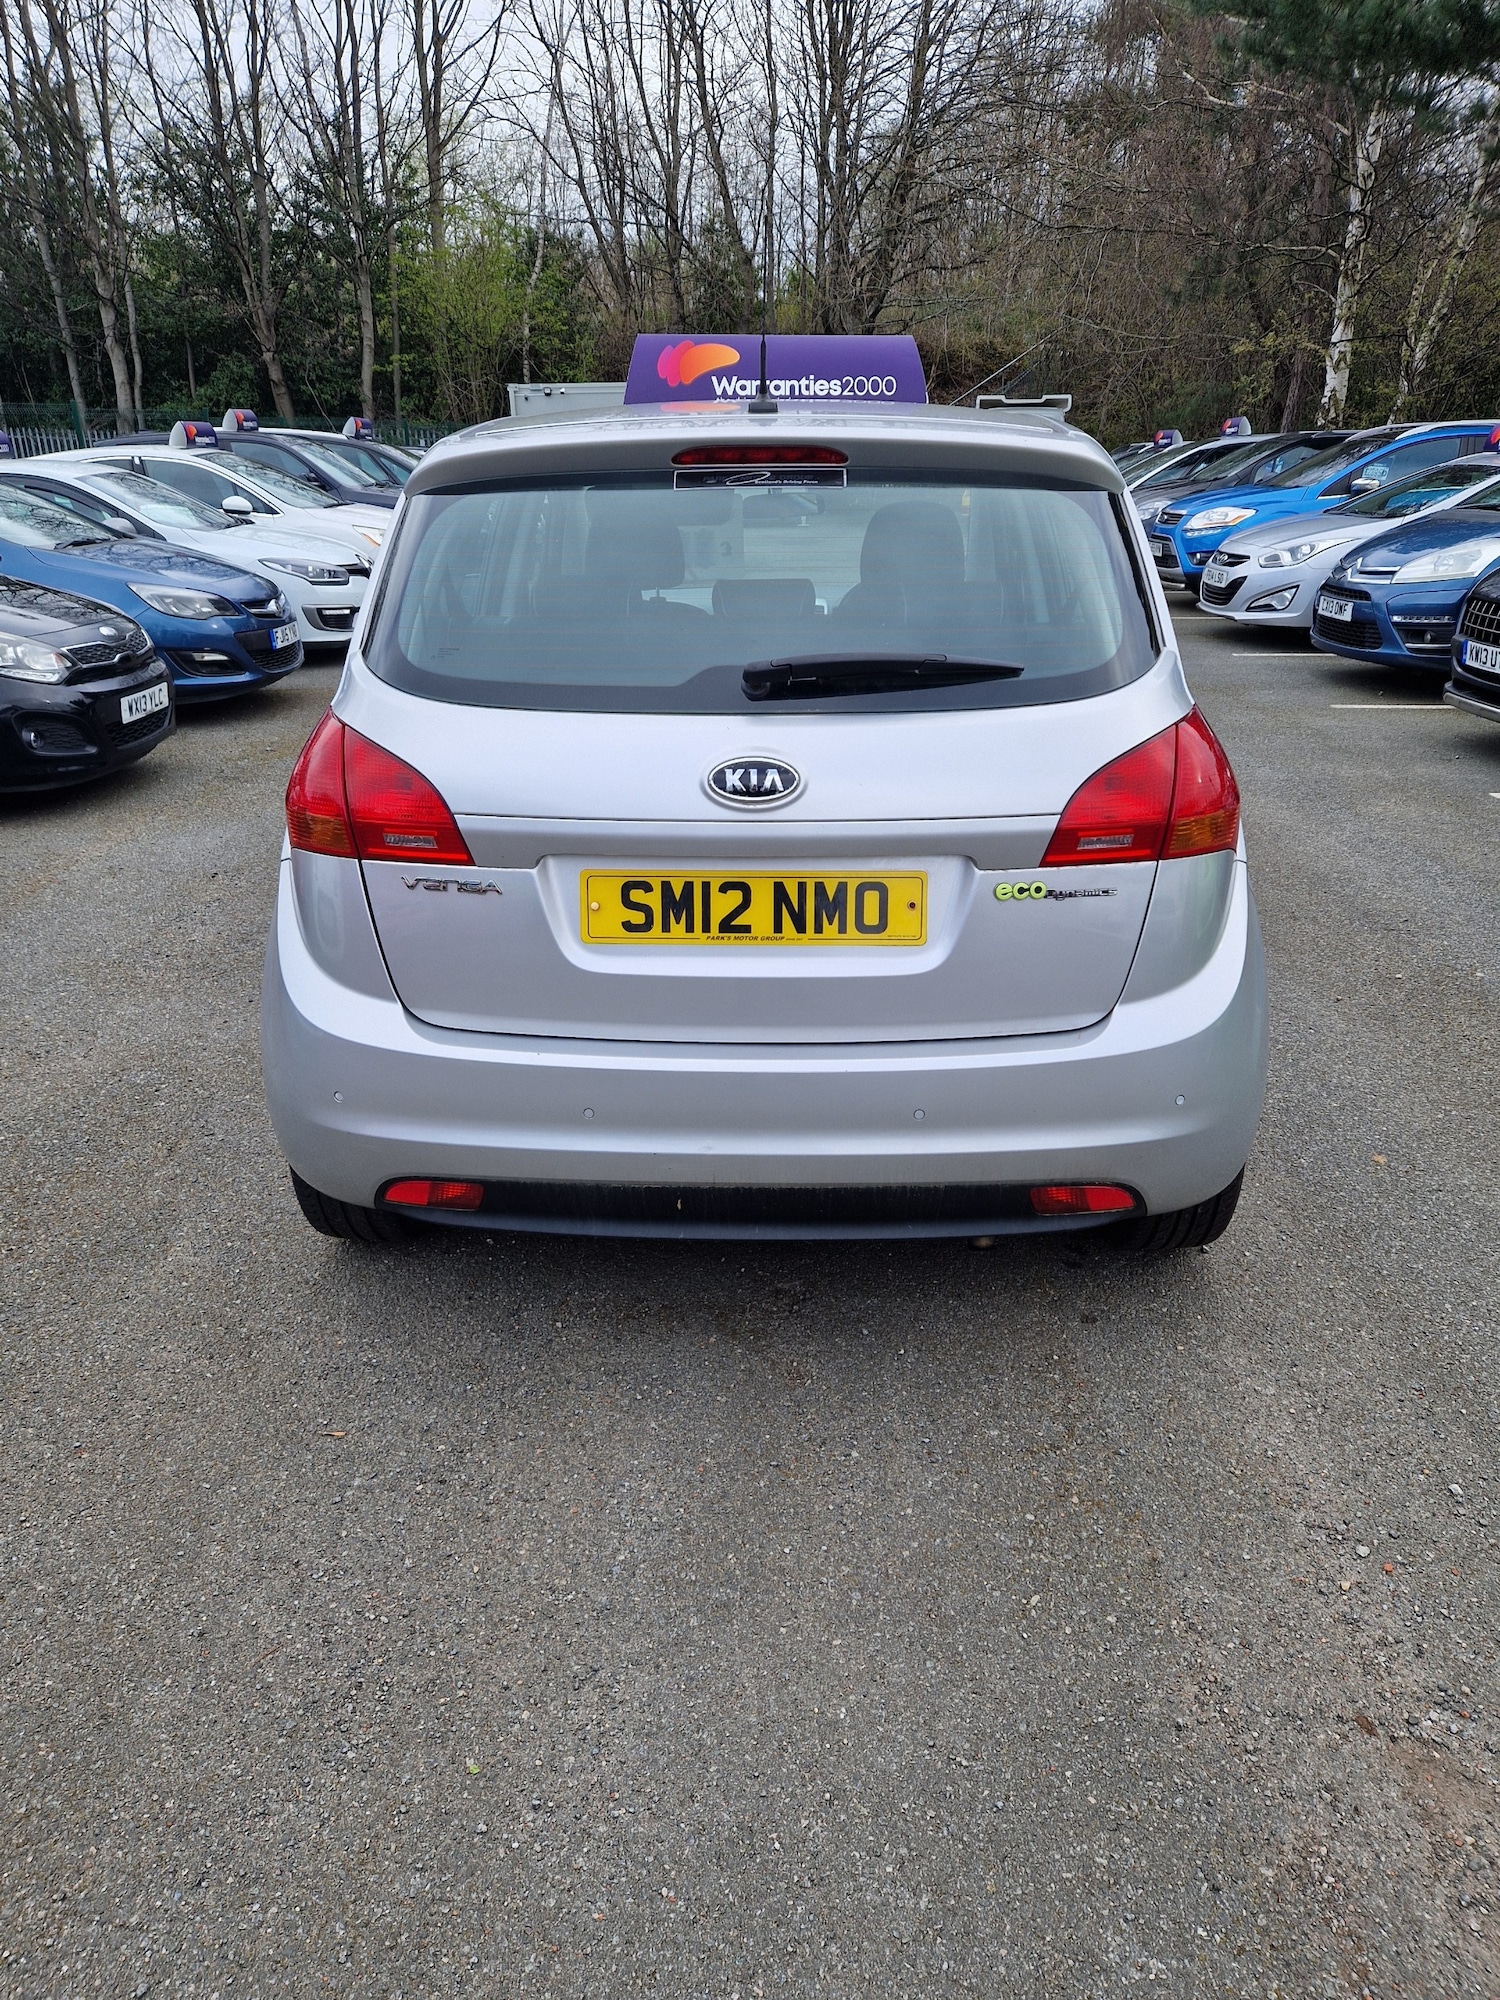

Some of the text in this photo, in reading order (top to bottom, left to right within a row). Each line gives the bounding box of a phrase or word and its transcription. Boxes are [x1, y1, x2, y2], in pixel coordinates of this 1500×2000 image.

[1490, 650, 1500, 669] U
[127, 688, 164, 717] WX13 YLC
[724, 768, 784, 792] KIA
[621, 880, 889, 934] SM12 NMO
